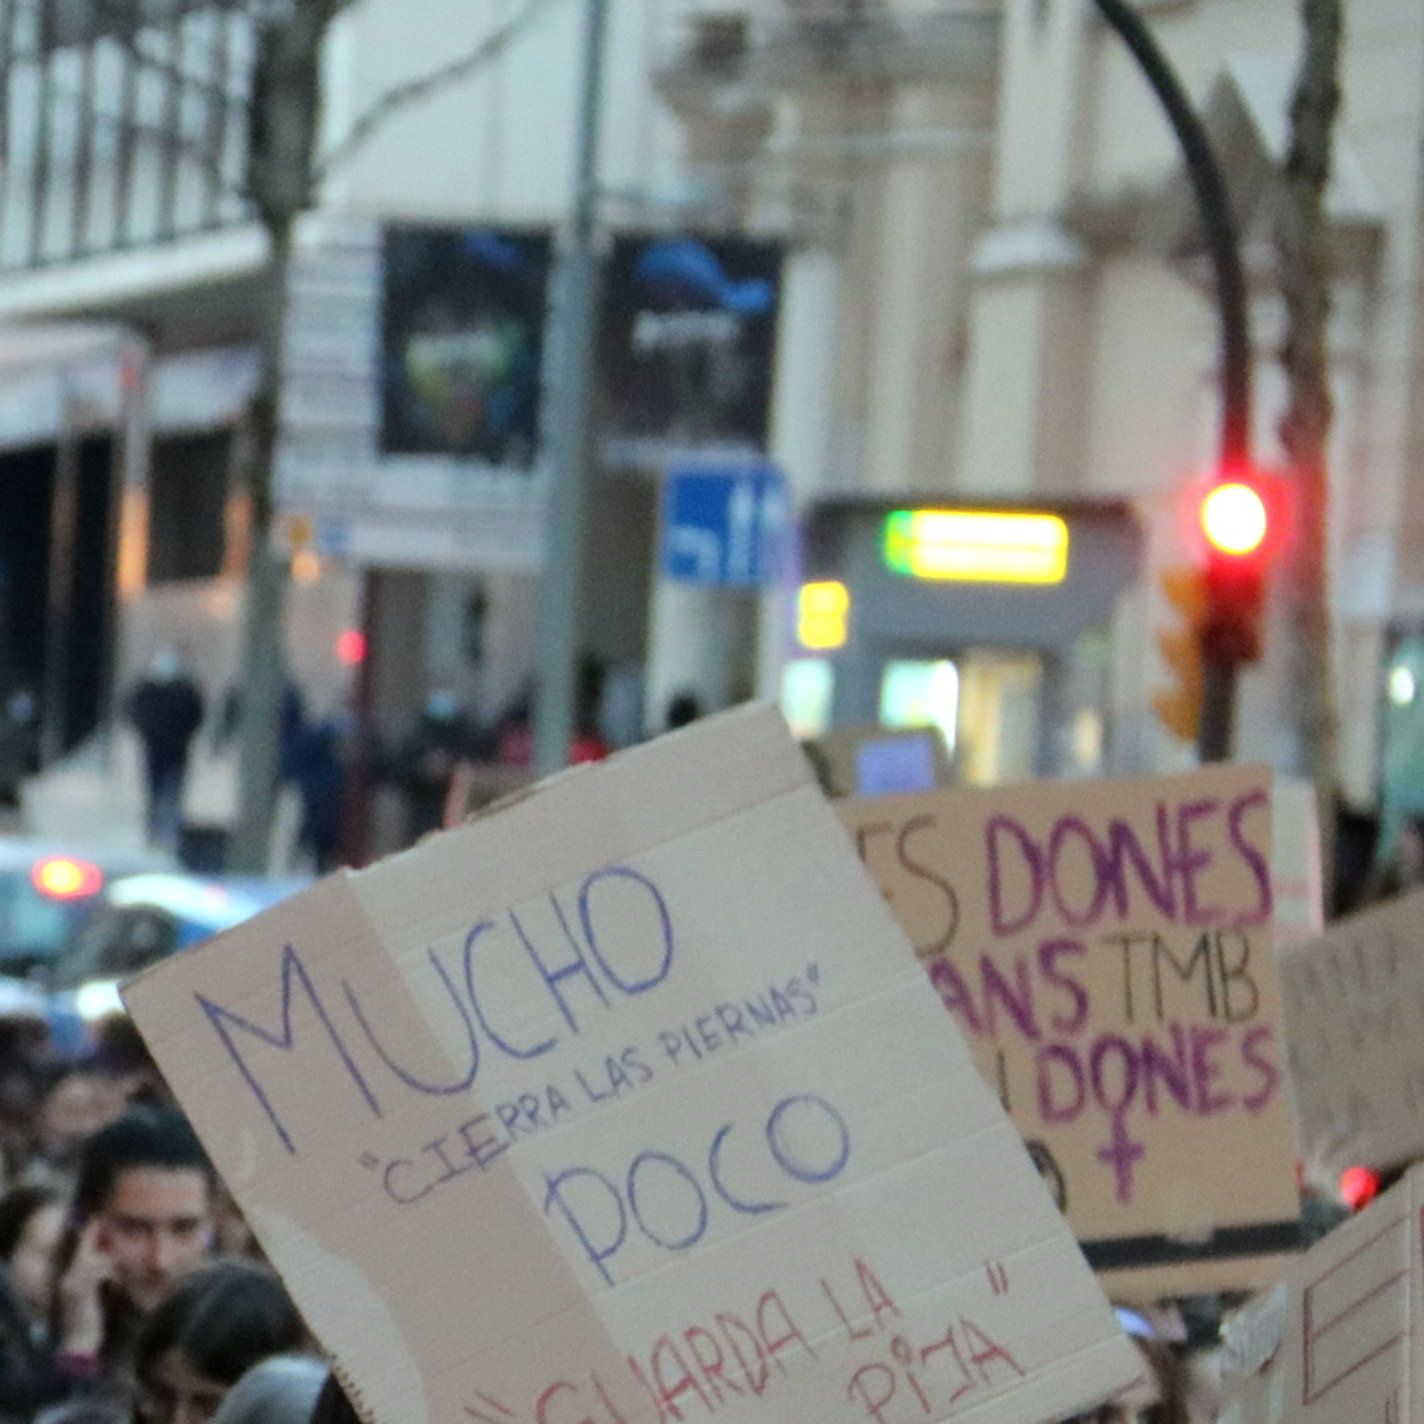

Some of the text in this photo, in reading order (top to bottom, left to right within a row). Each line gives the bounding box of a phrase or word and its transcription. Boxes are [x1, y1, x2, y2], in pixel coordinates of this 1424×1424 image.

[986, 787, 1274, 937] DONES
[194, 866, 673, 1154] MUCHO
[1103, 929, 1260, 1023] TMB
[574, 1048, 653, 1103] LAS
[1037, 1022, 1280, 1124] DONES
[545, 1094, 851, 1286] POCO
[821, 1257, 903, 1339] LA
